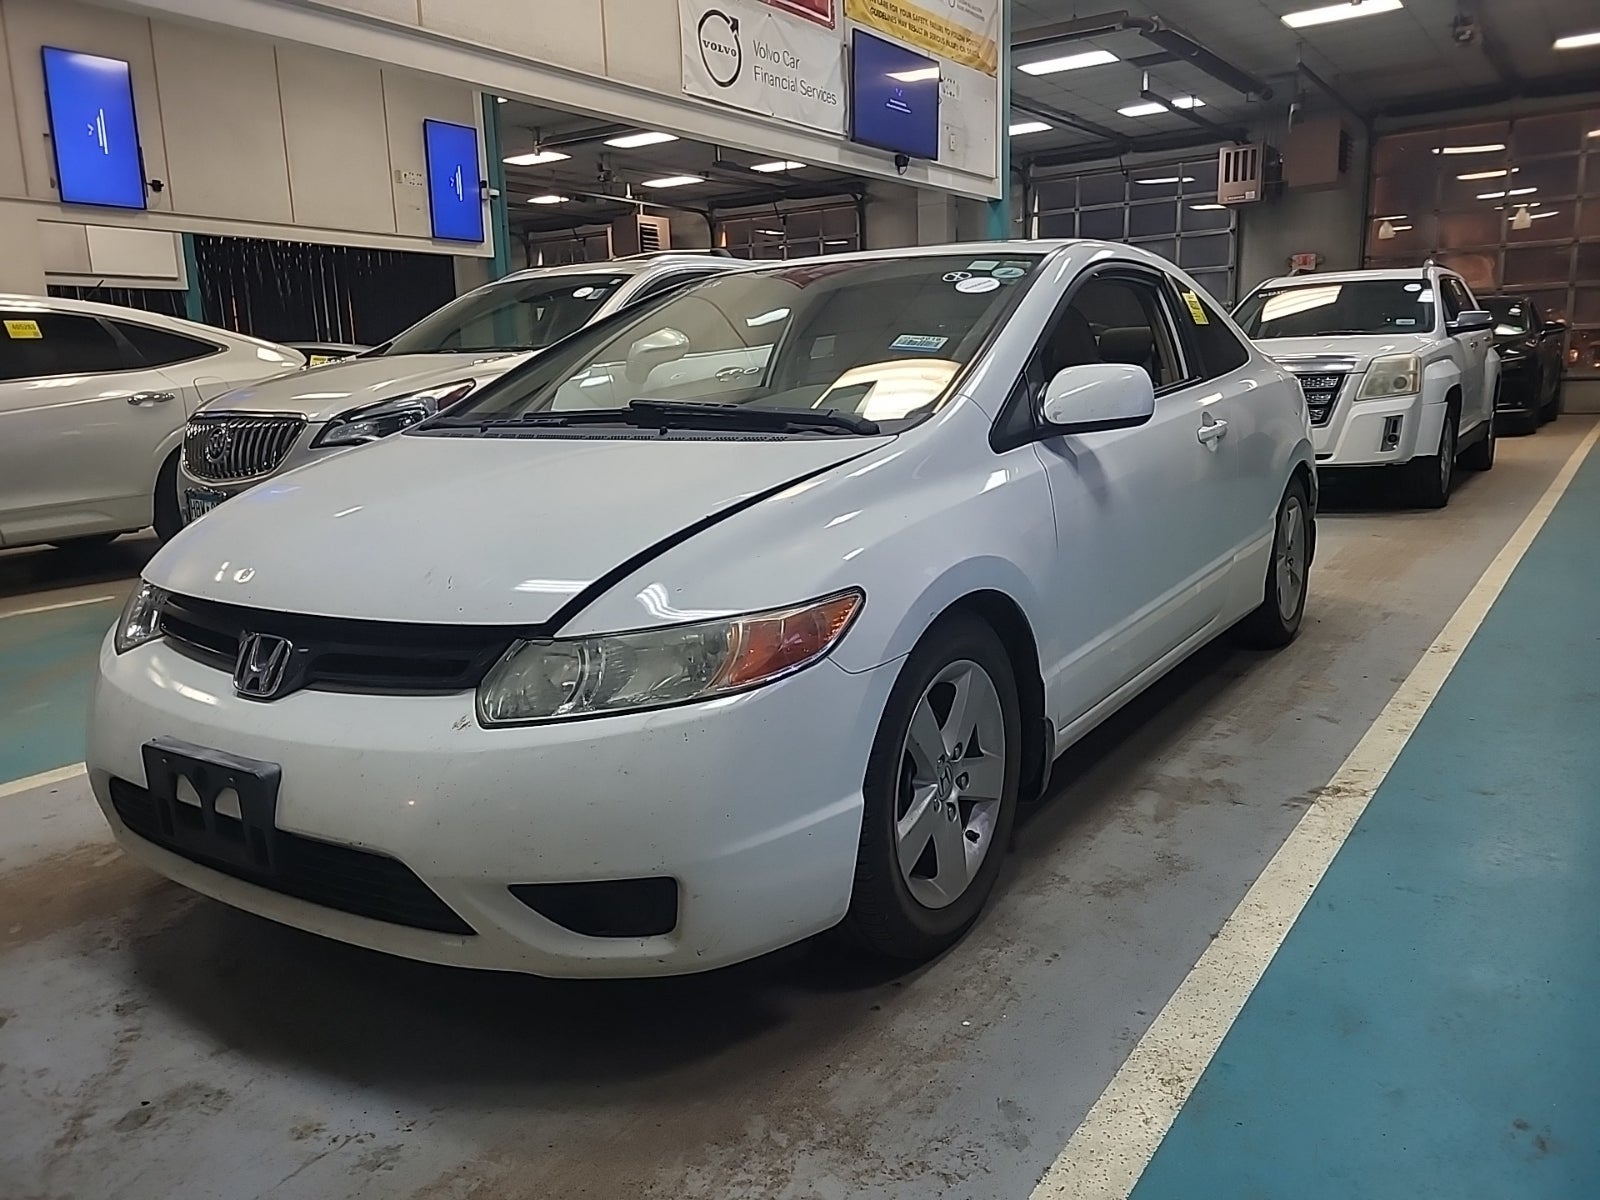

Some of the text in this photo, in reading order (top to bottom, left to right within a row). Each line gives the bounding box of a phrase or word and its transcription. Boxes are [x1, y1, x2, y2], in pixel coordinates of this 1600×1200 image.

[870, 7, 897, 24] GUIDELINES
[889, 3, 898, 13] FOR
[899, 8, 912, 18] YOUR
[702, 39, 737, 57] VOLVO
[753, 40, 800, 70] Volvo Car
[753, 65, 837, 105] Financial Services
